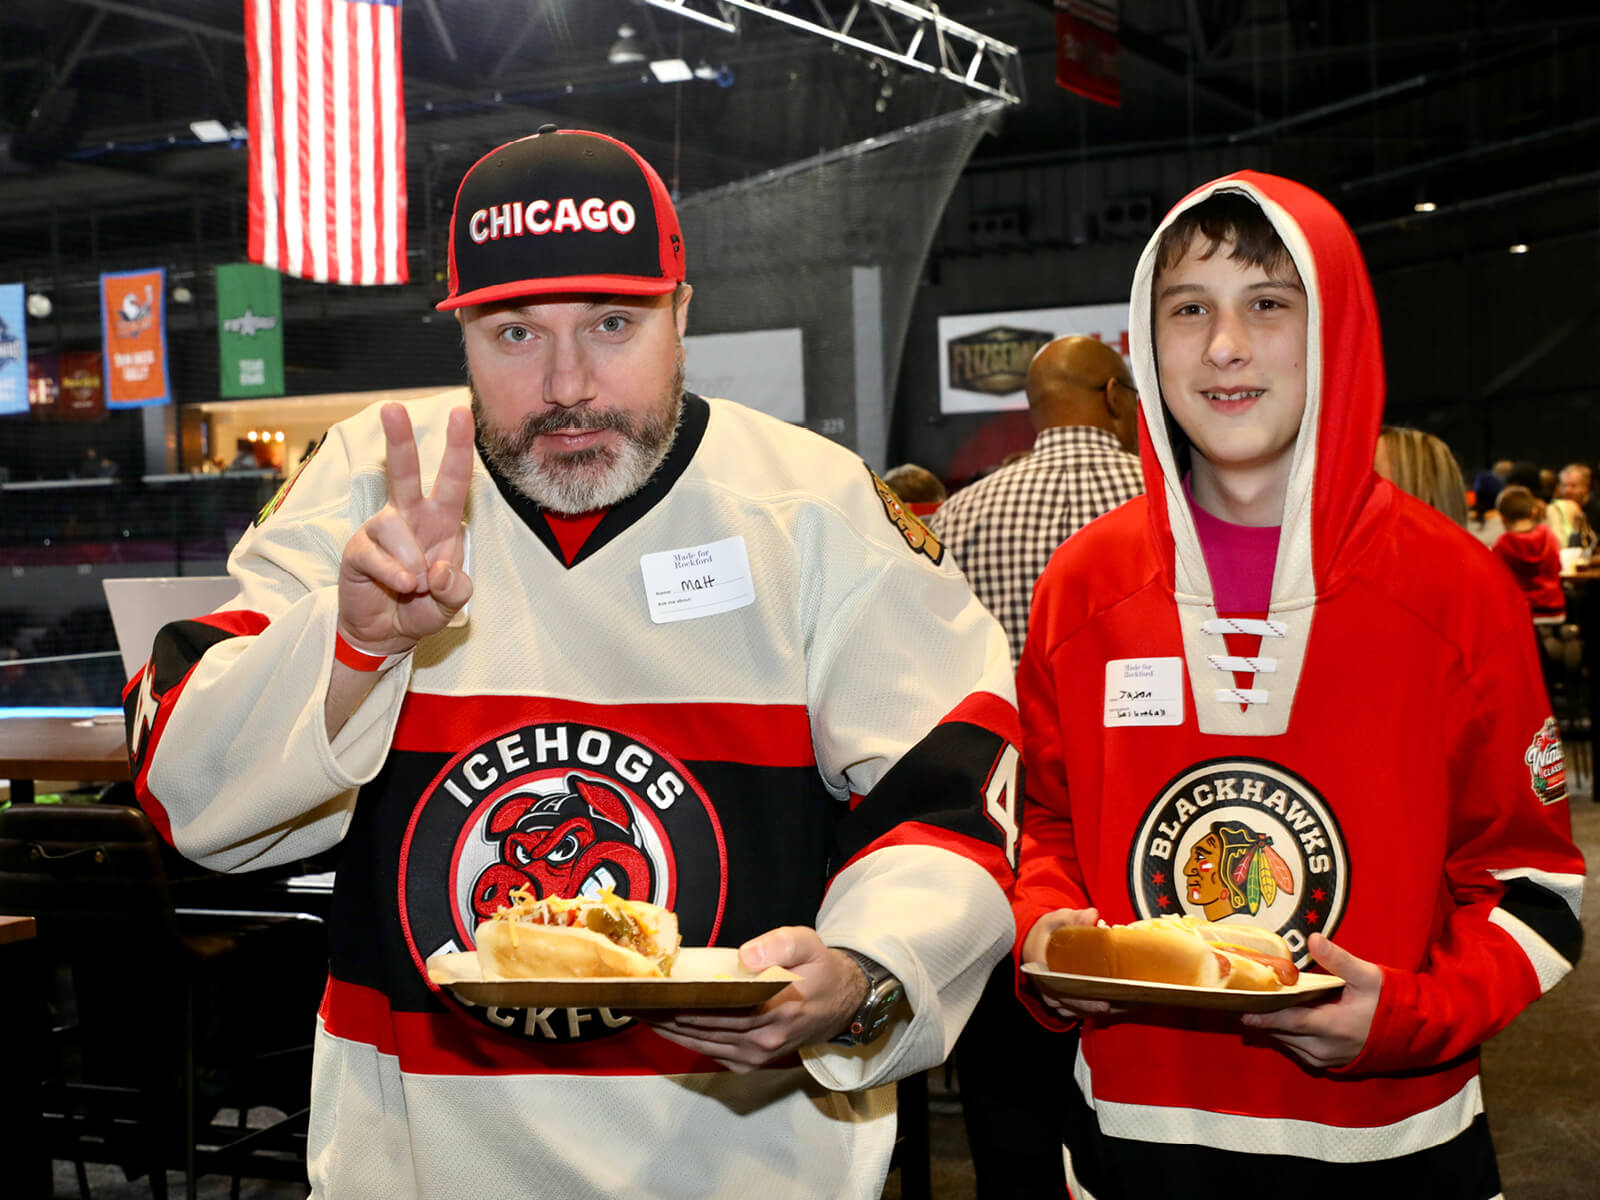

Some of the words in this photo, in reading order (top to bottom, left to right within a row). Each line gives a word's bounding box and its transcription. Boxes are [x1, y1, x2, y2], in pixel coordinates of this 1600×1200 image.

[469, 197, 636, 244] CHICAGO
[673, 552, 696, 562] Made
[697, 550, 710, 560] for
[674, 555, 713, 569] Rockford
[443, 726, 685, 810] ICEHOGS
[1149, 777, 1331, 875] BLACKHAWKS
